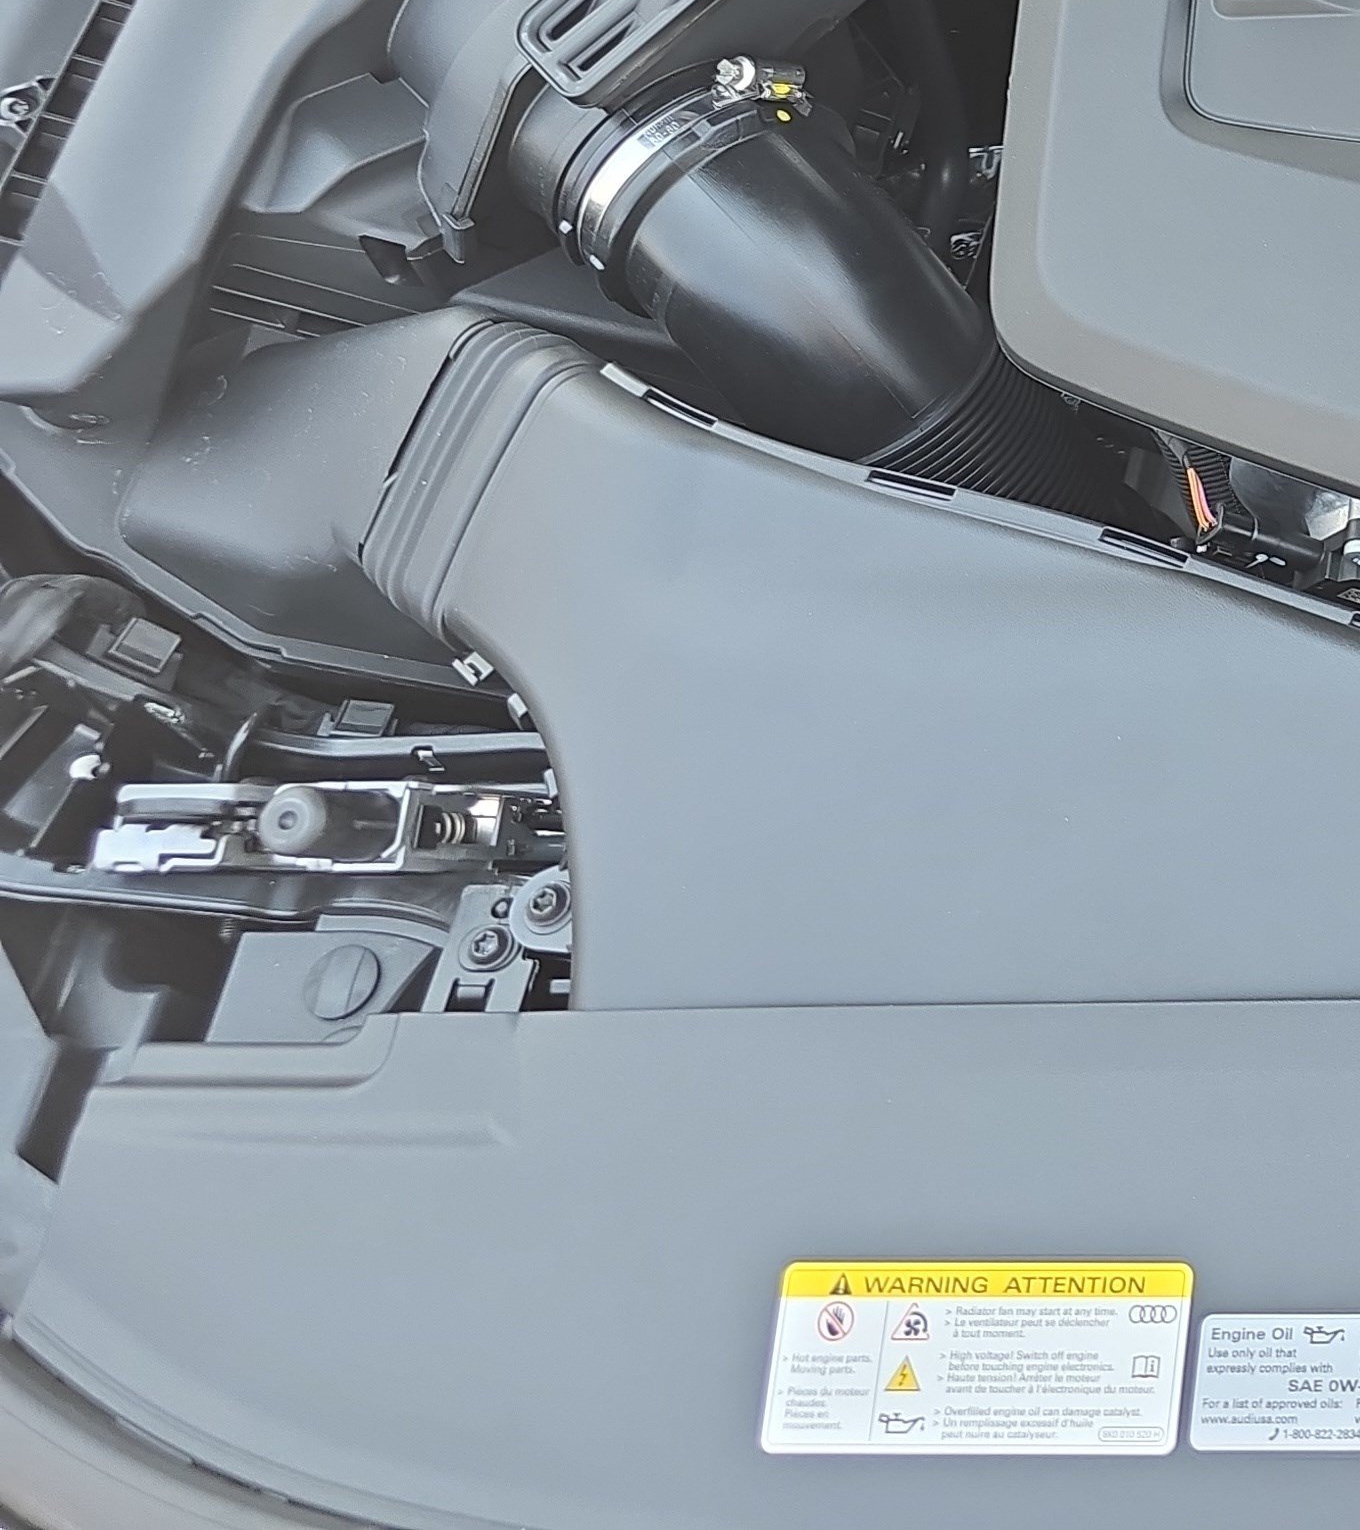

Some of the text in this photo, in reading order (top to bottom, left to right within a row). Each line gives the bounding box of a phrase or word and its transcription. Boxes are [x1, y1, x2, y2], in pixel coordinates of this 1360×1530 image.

[864, 1276, 1146, 1294] WARNING ATTENTION
[956, 1306, 1119, 1318] Radiator fan may start at any time.
[1211, 1327, 1294, 1343] Engine Oil
[950, 1351, 1099, 1363] High voltage! Switch off engine
[1208, 1348, 1298, 1361] Use only oil that
[1206, 1363, 1334, 1376] expressly complies with
[1287, 1379, 1324, 1393] SAE
[1202, 1398, 1343, 1412] For a list of approved oils:
[1200, 1413, 1299, 1424] www.audiusa.com
